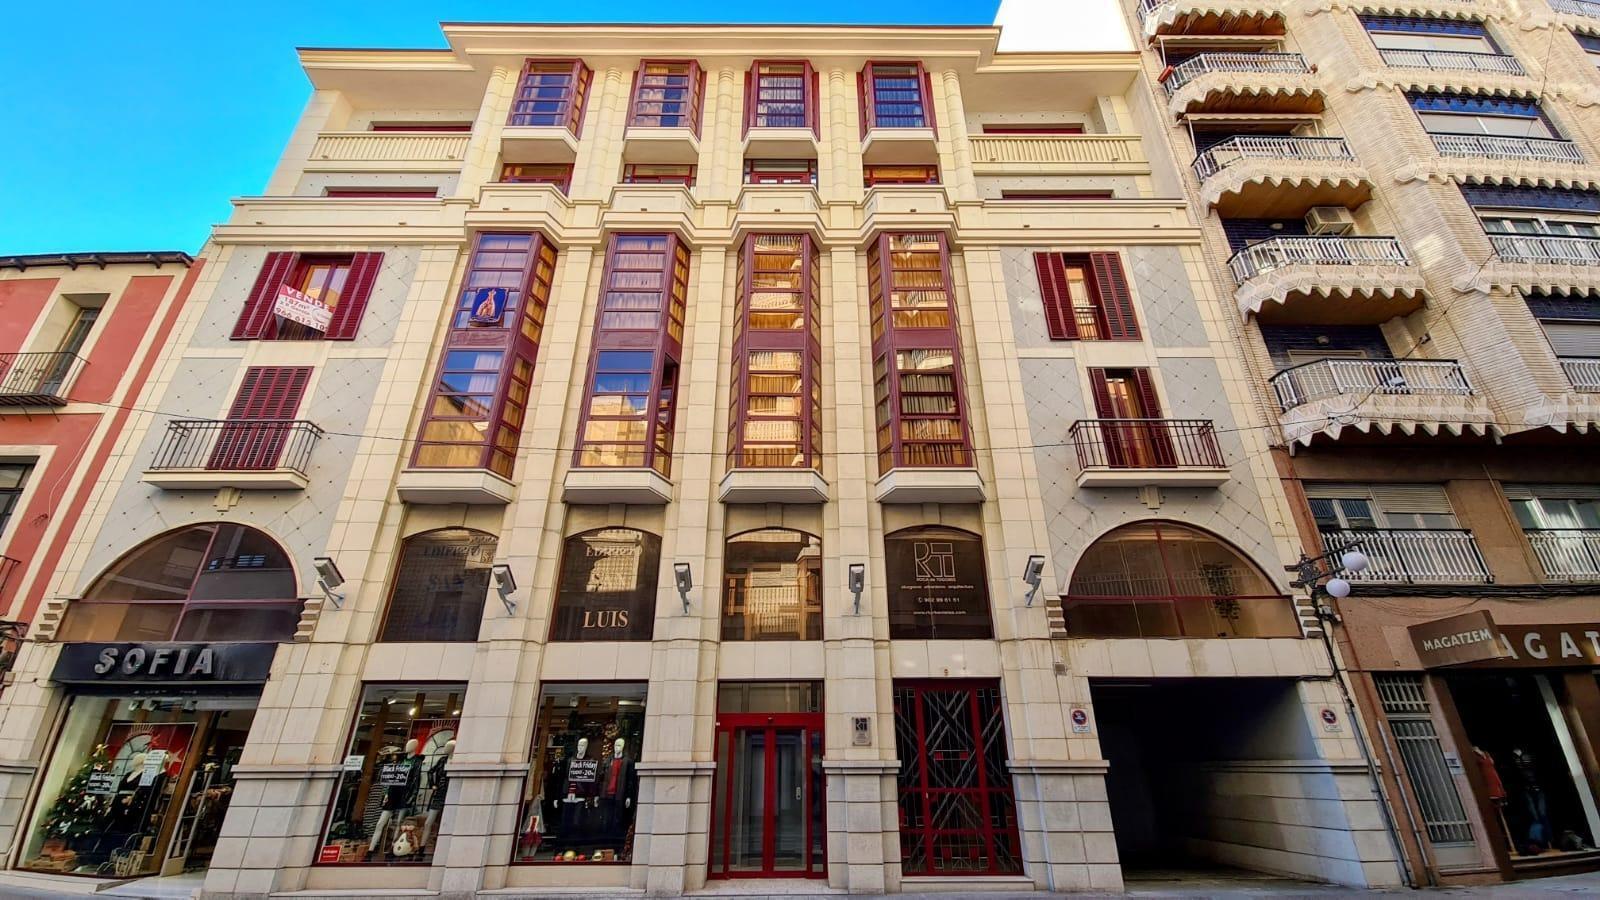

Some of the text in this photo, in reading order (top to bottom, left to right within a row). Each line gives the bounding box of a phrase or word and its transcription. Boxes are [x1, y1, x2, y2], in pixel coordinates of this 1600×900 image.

[286, 286, 329, 309] VENDE
[583, 610, 629, 628] LUIS
[1423, 628, 1492, 652] MAGATZEM
[94, 647, 213, 675] SOFIA
